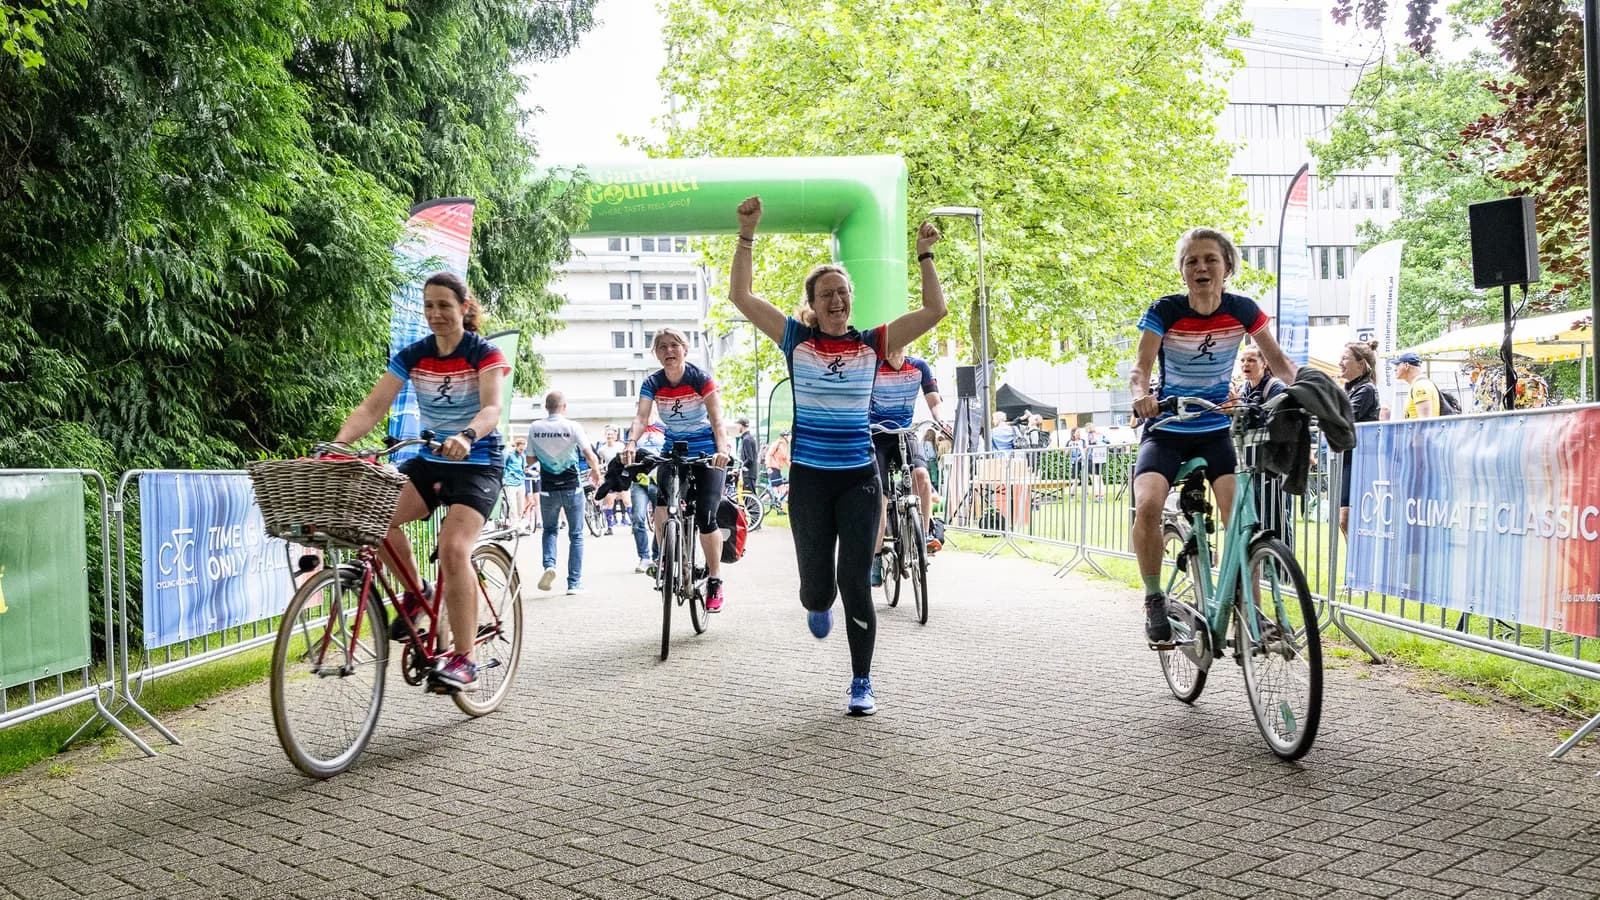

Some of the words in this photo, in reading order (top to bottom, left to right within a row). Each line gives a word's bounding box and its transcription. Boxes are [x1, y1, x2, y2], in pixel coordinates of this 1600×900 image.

[585, 175, 700, 205] Gourmet
[1405, 498, 1488, 534] CLIMATE
[1495, 502, 1600, 542] CLASSIC
[208, 524, 241, 551] TIME
[208, 552, 248, 580] ONLY
